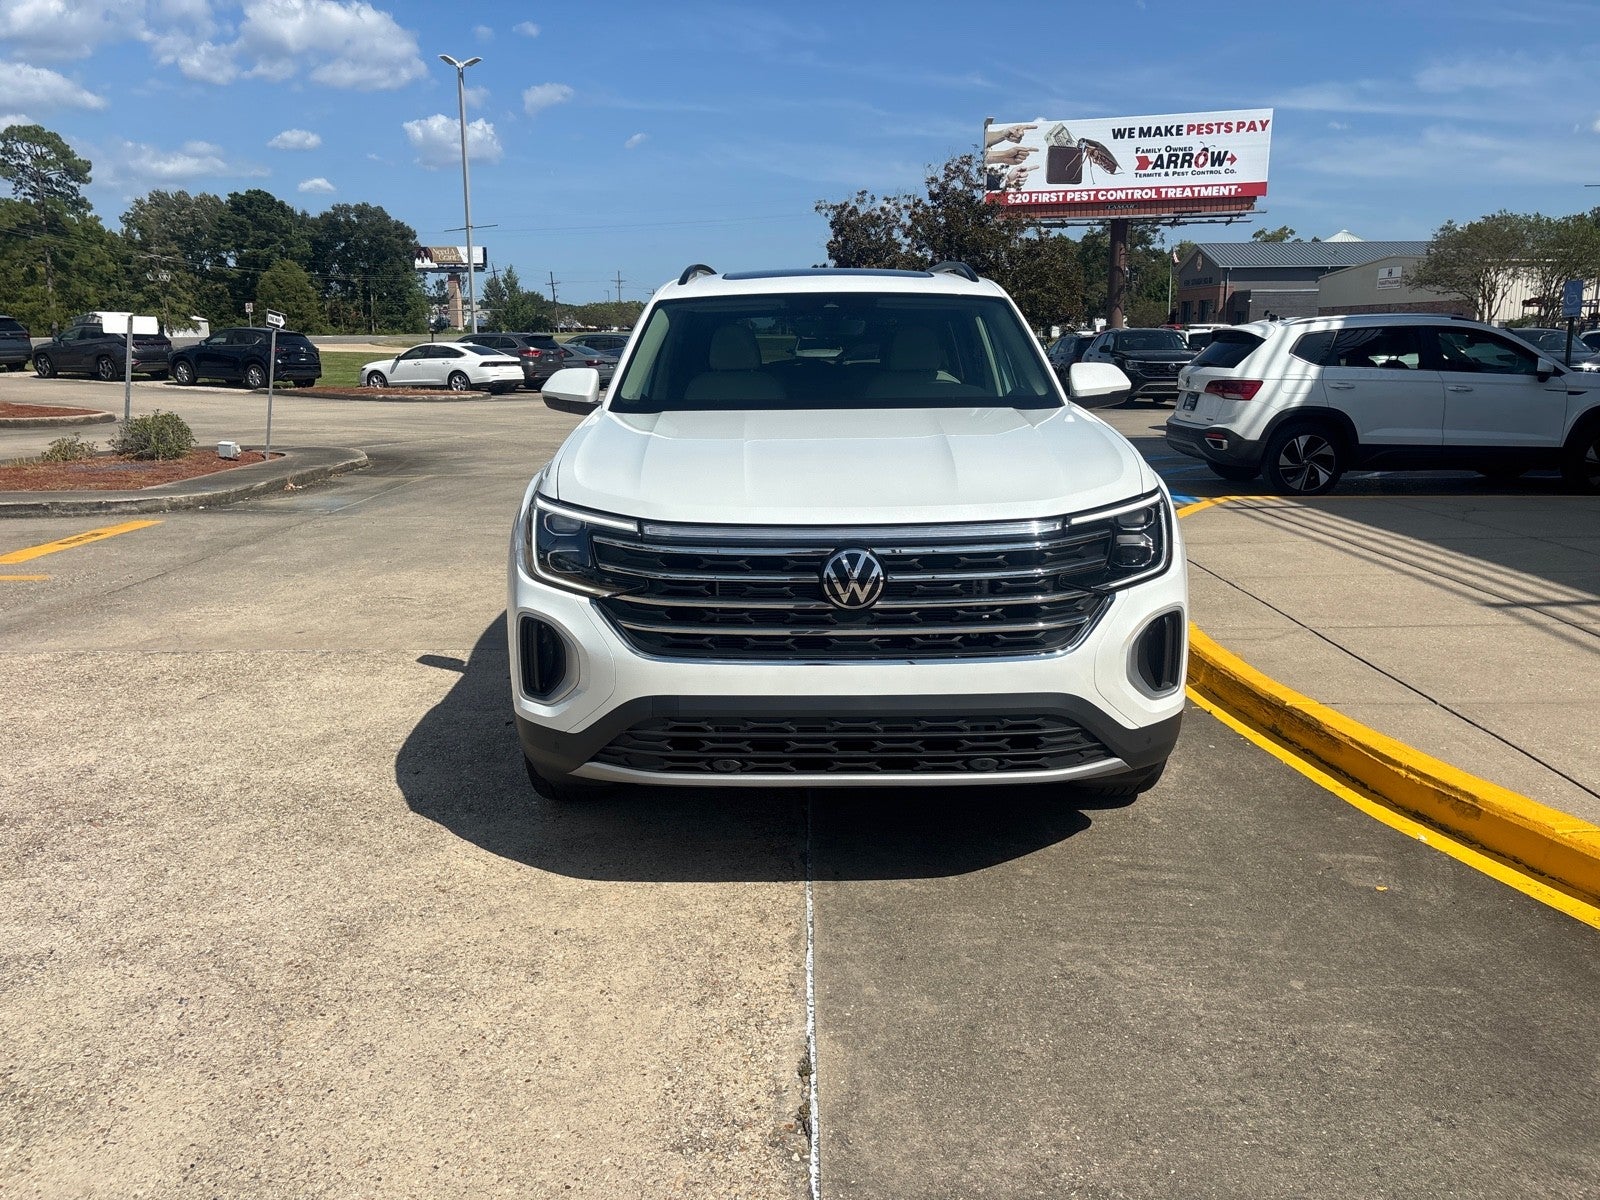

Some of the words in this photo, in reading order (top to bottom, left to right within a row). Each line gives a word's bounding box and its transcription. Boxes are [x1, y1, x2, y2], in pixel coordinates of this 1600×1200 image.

[1112, 127, 1136, 139] WE
[1138, 124, 1184, 138] MAKE
[1186, 121, 1233, 136] PESTS
[1236, 119, 1270, 133] PAY
[1135, 146, 1162, 154] FAMILY
[1164, 145, 1194, 153] OWNED
[1151, 149, 1229, 170] ARROW
[1007, 193, 1030, 204] $20
[1031, 192, 1065, 203] FIRST
[1066, 190, 1097, 202] PEST
[1097, 187, 1158, 201] CONTROL
